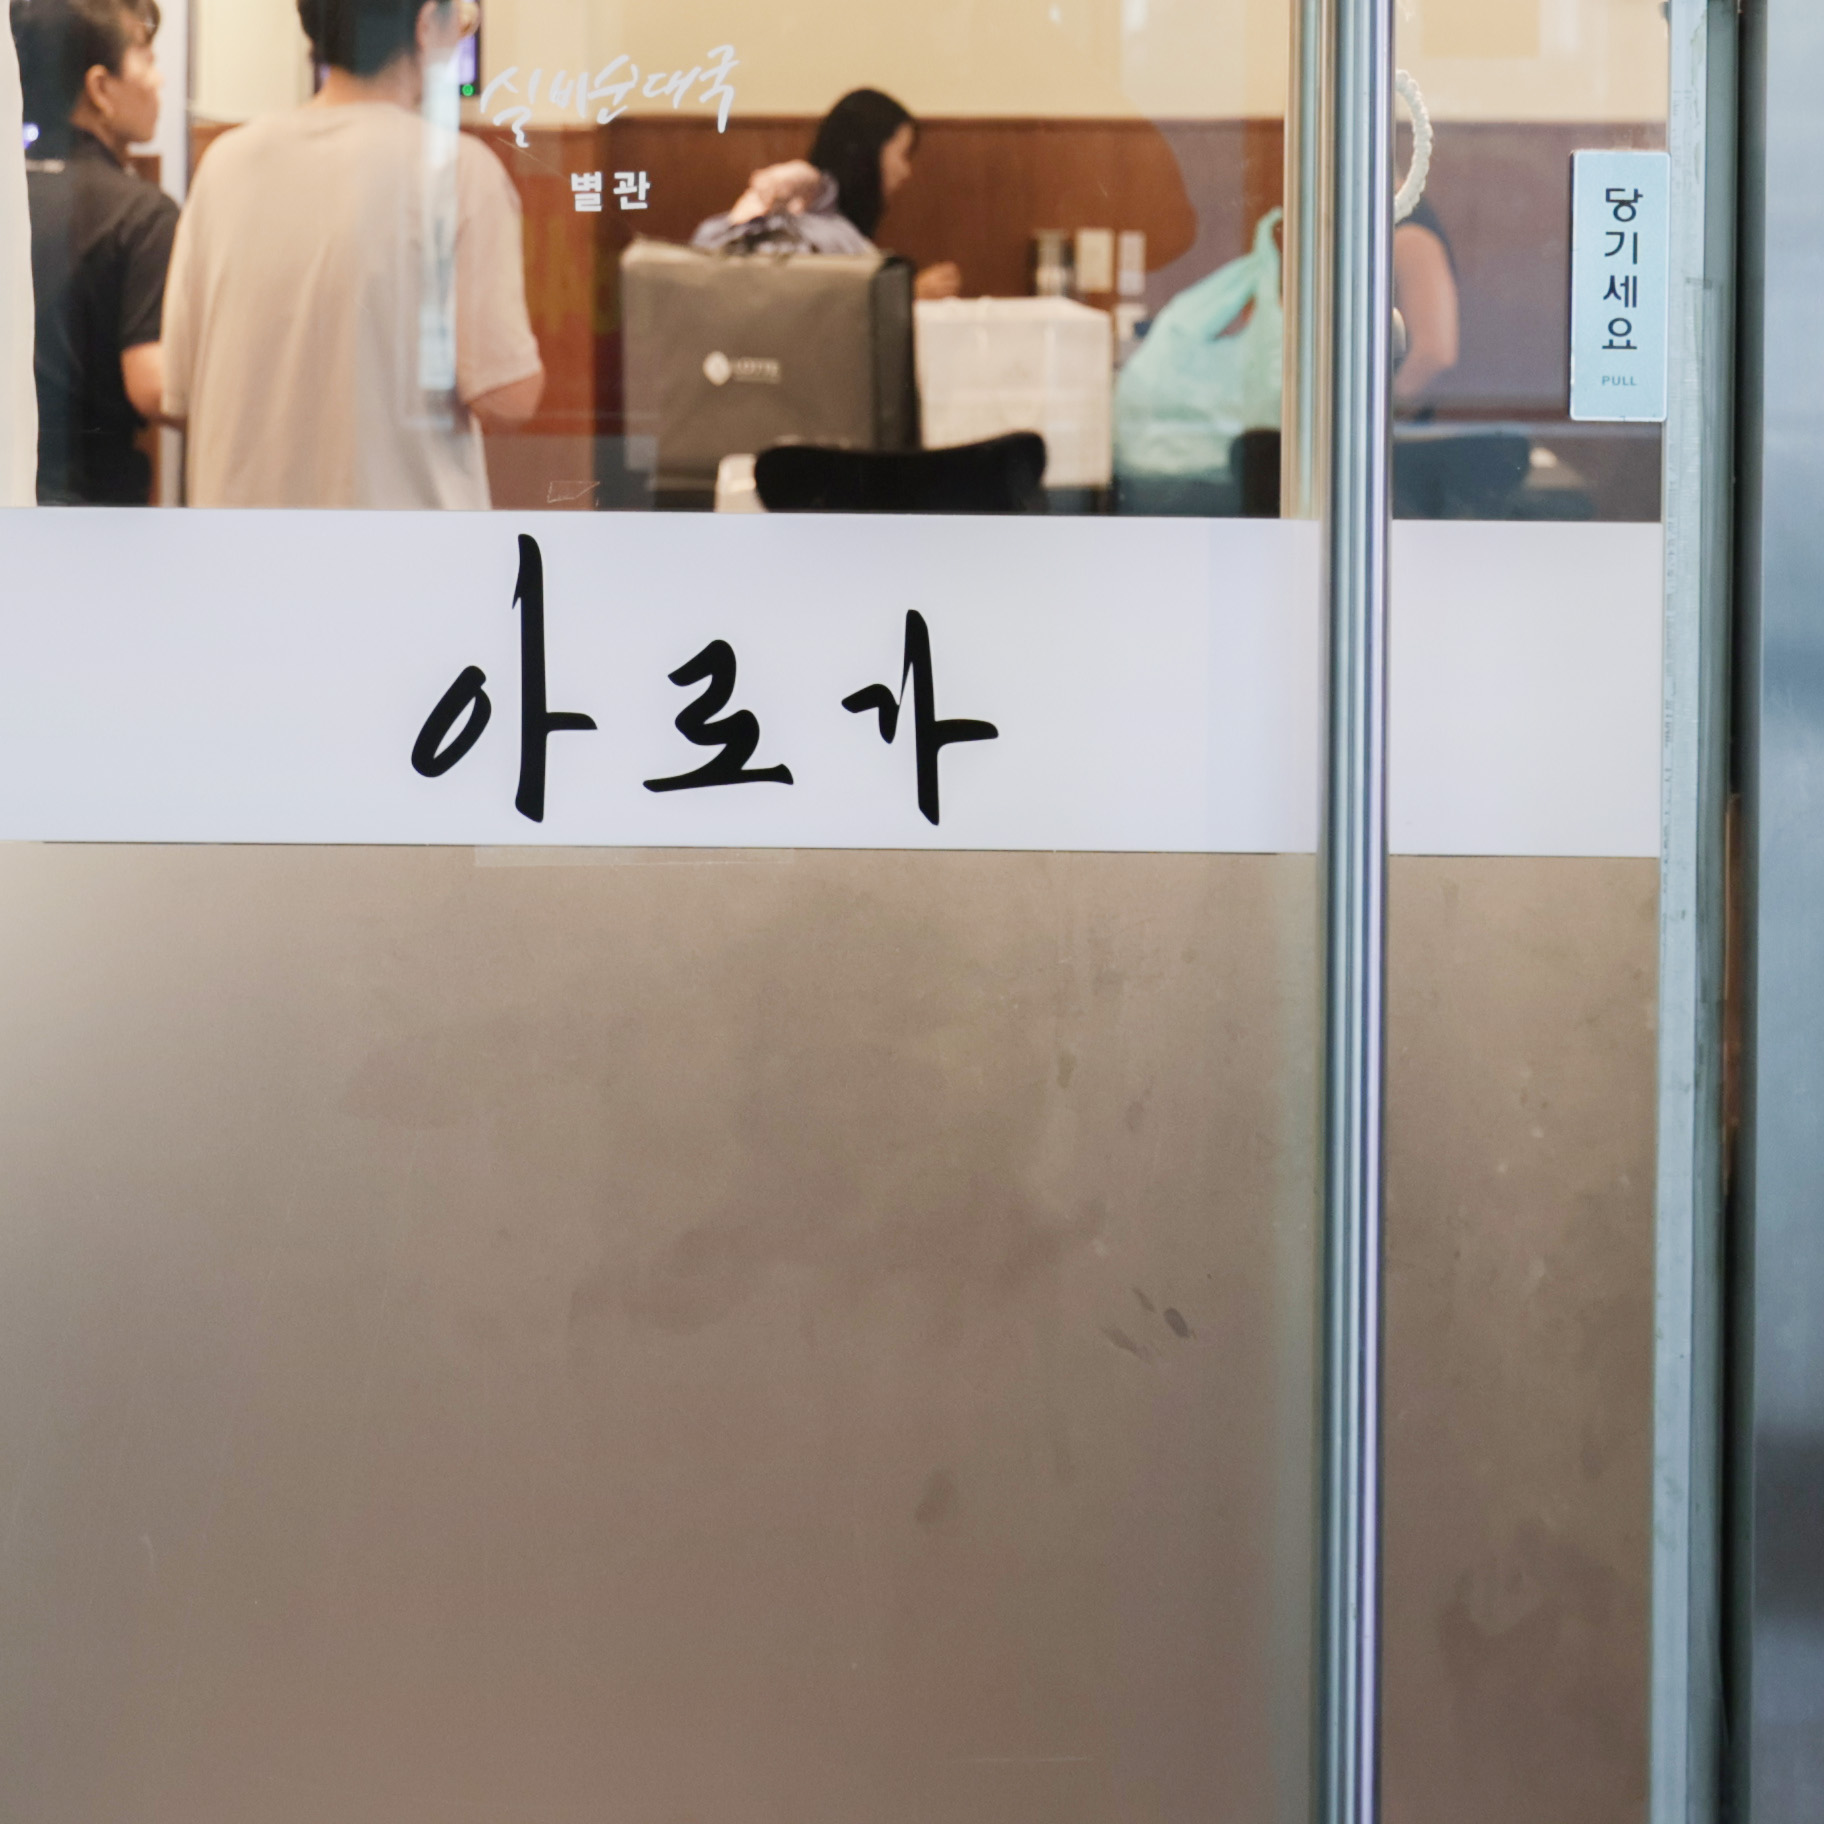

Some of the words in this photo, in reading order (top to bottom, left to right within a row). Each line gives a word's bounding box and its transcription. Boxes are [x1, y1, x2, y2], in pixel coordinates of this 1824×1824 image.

[571, 171, 651, 212] 별관
[1602, 188, 1644, 350] 당기세요
[1601, 375, 1637, 386] PULL
